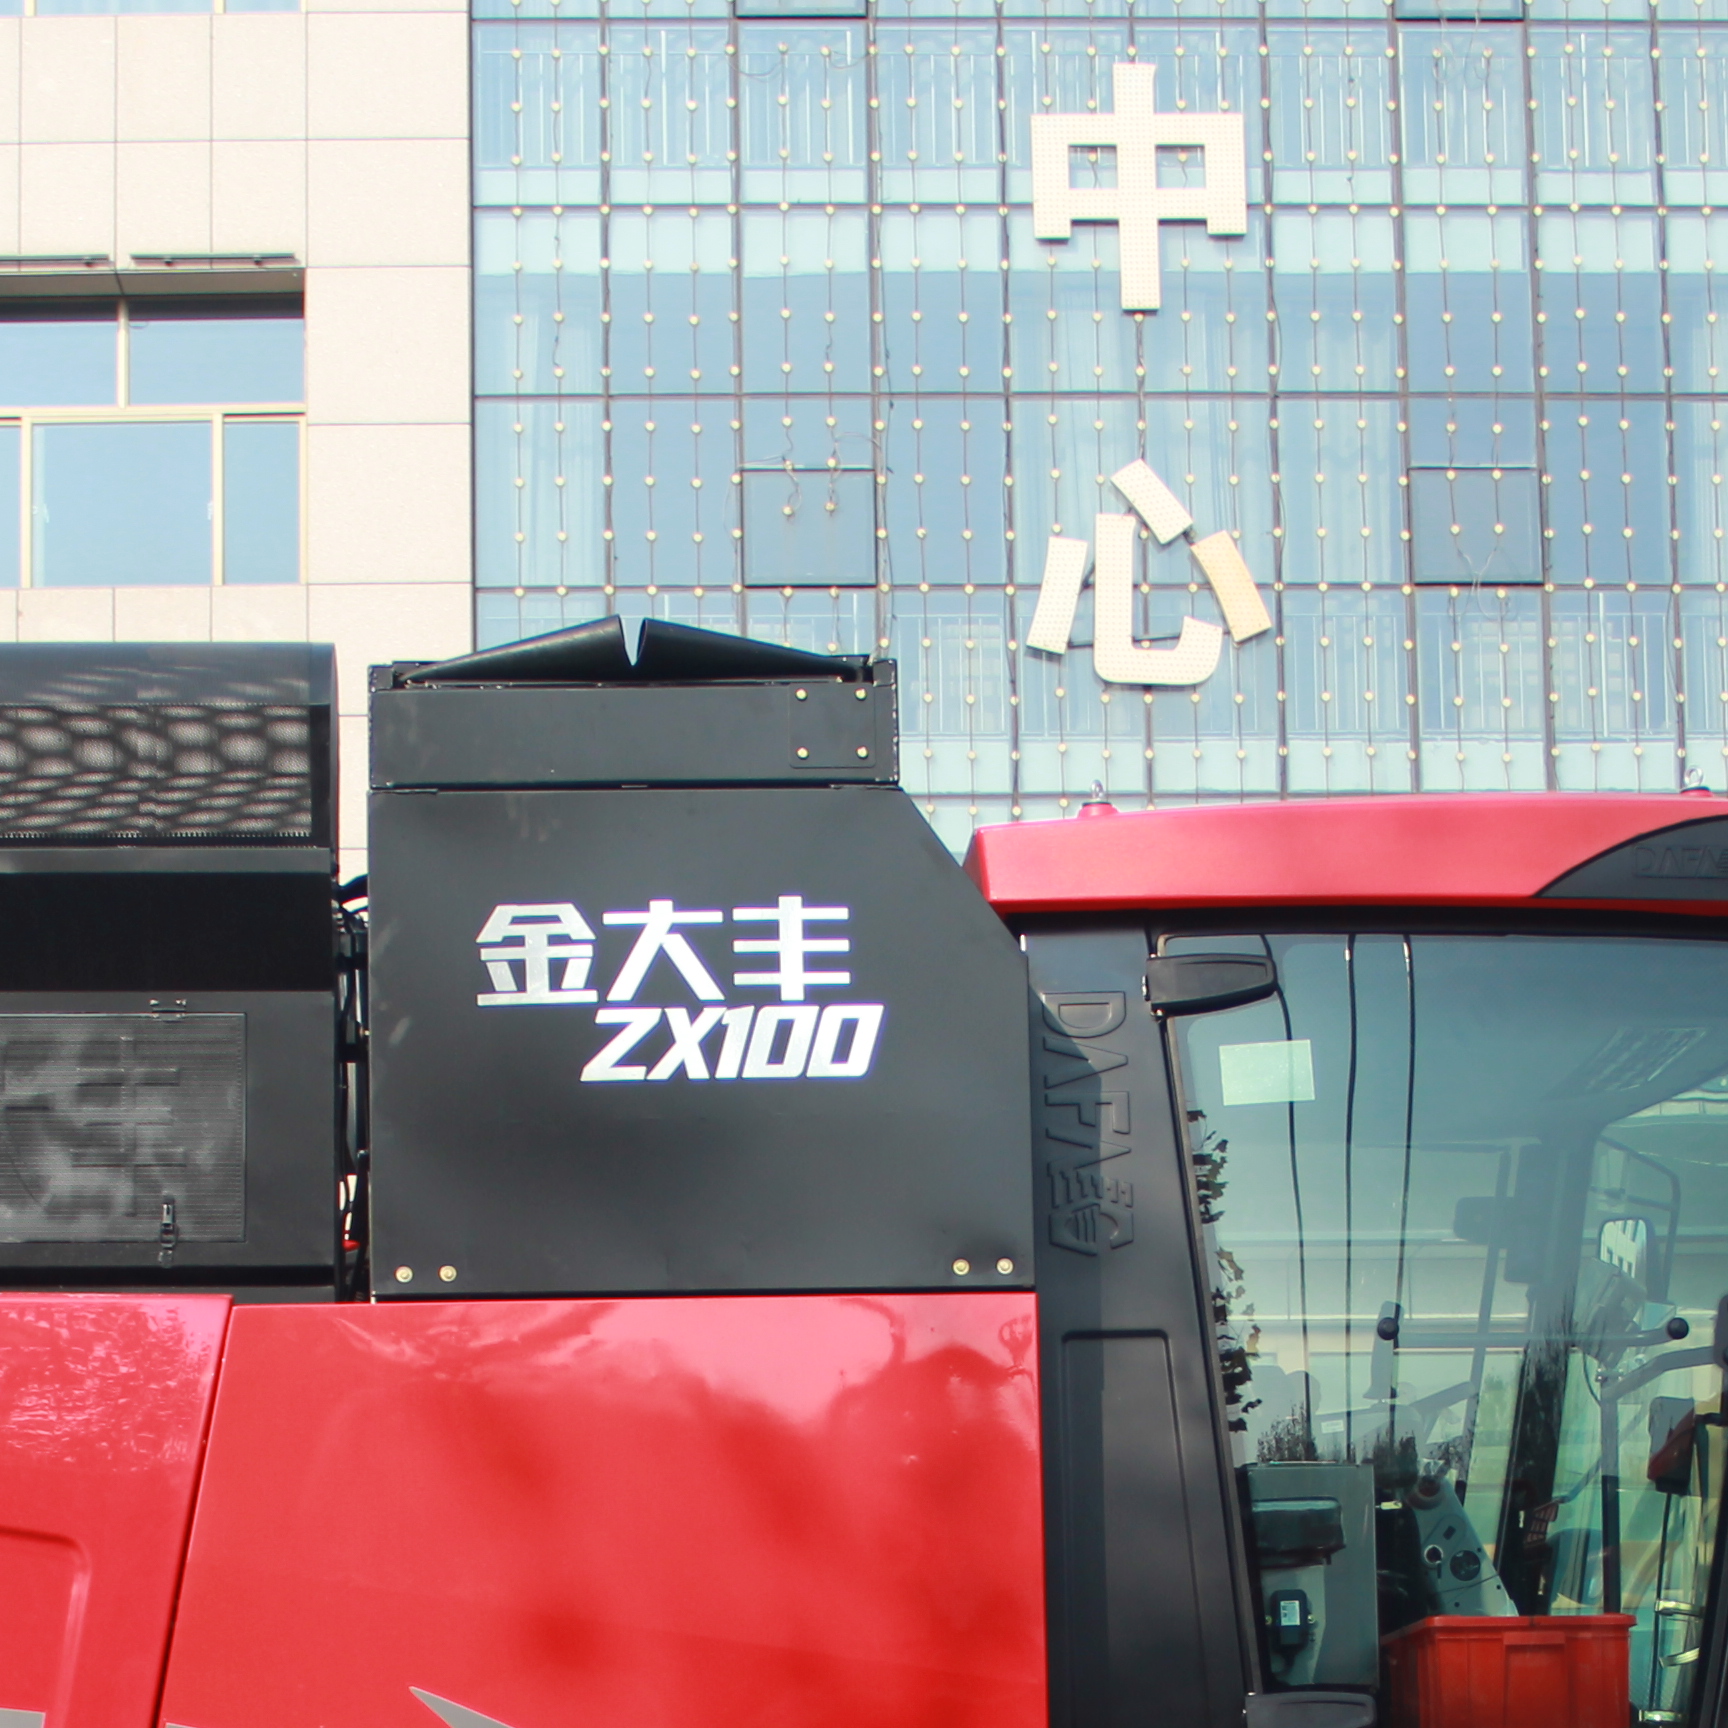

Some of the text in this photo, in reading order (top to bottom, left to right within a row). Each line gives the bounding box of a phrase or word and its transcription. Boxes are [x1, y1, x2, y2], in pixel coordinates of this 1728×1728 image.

[1026, 62, 1273, 686] 中心
[476, 895, 851, 1006] 金大丰
[580, 1004, 884, 1082] ZX100
